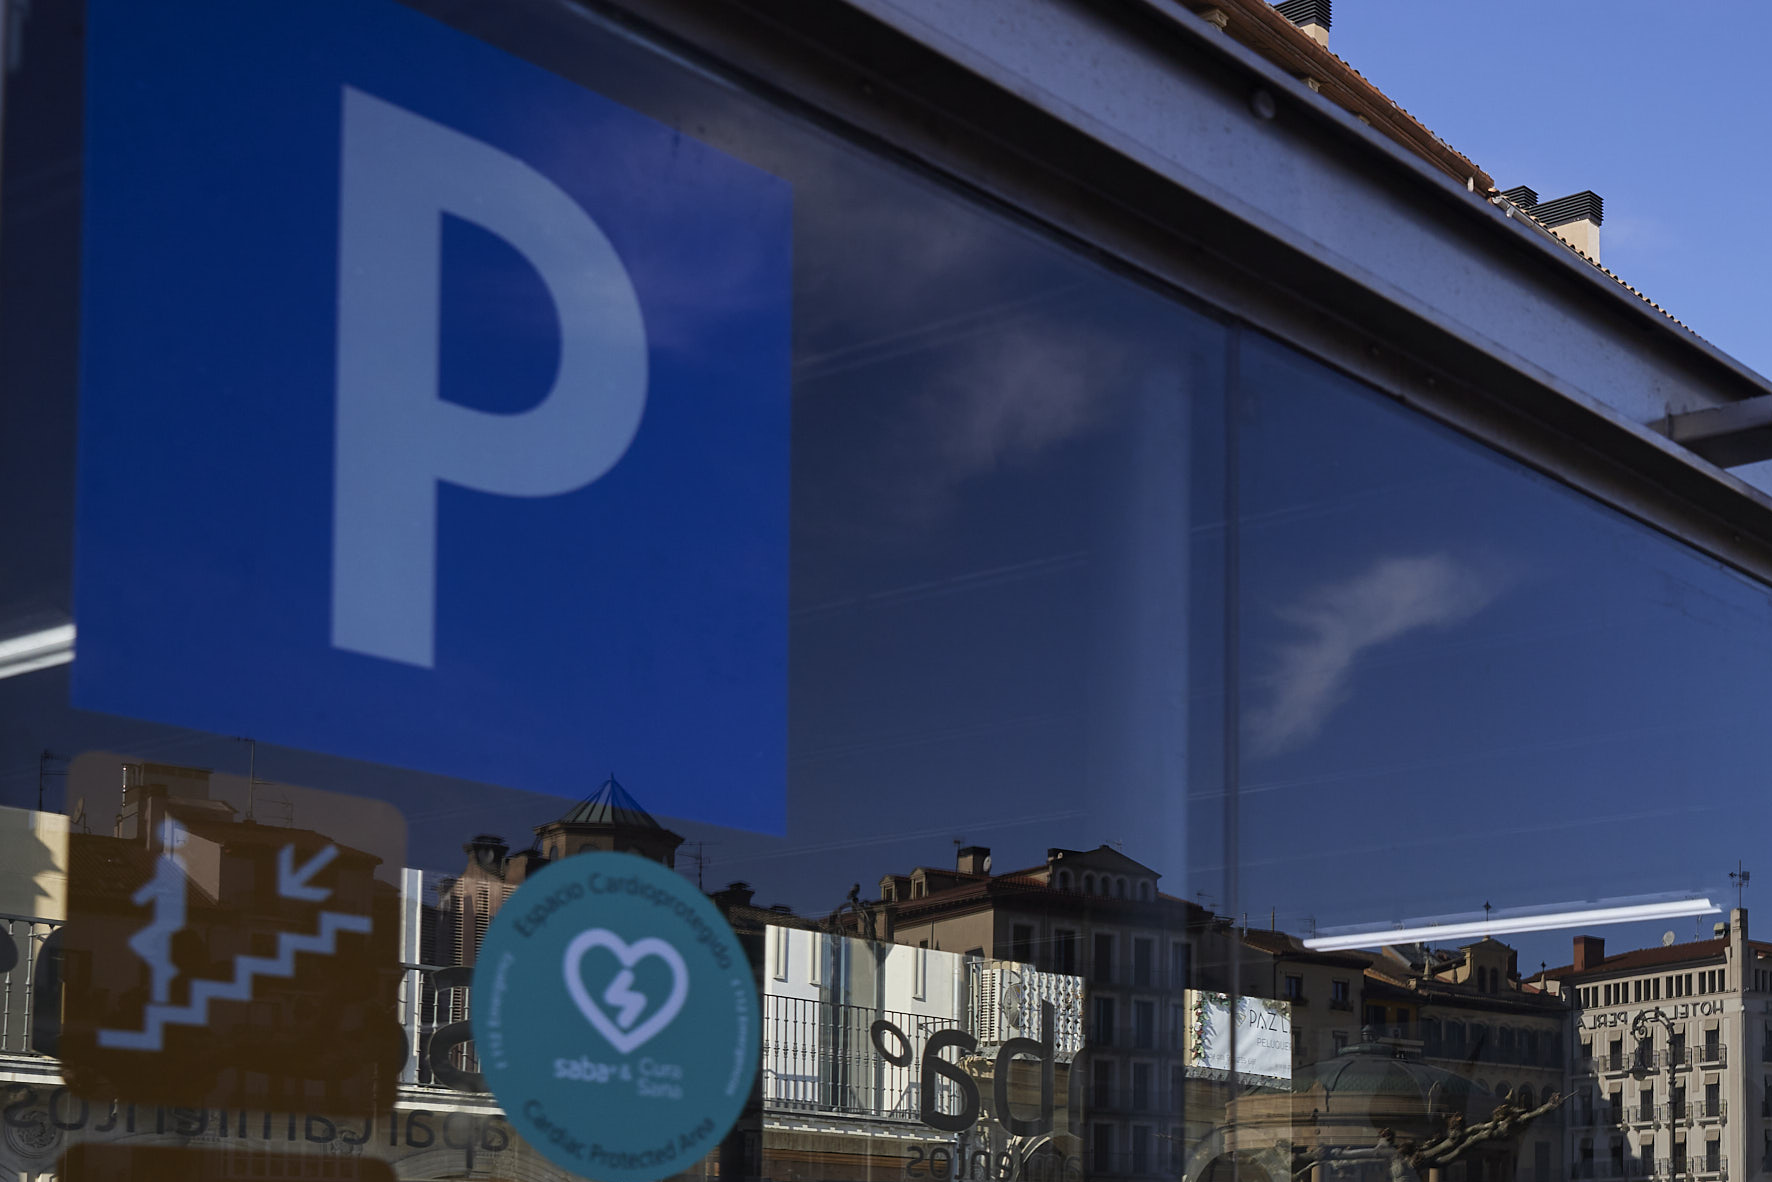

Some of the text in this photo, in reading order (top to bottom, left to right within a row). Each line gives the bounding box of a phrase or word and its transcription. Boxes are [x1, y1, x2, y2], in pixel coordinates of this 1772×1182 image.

[330, 86, 651, 671] P
[513, 871, 733, 971] Espacio Cardioprotegido
[637, 1056, 684, 1079] Cura
[523, 1098, 717, 1170] Cardiac Protected Area
